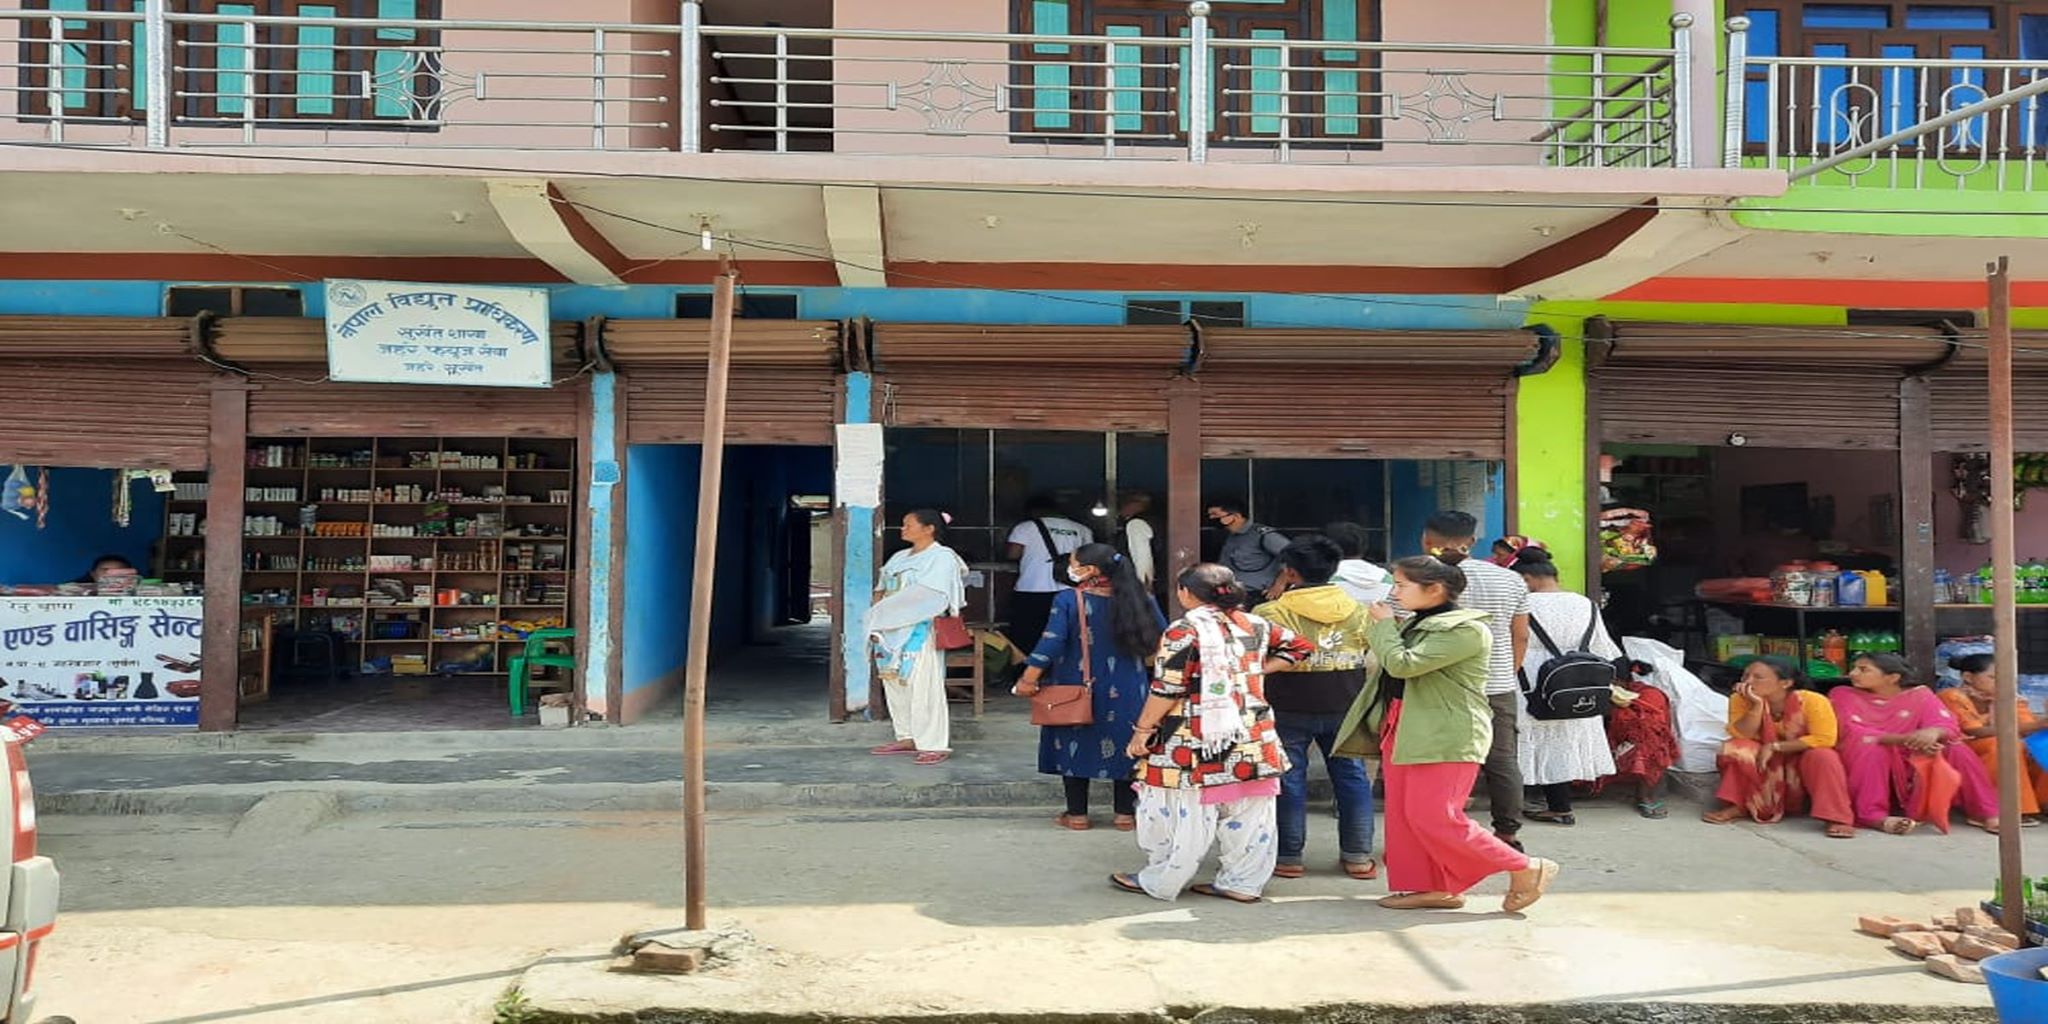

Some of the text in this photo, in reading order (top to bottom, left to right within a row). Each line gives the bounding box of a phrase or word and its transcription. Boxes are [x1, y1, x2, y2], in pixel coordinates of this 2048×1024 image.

[448, 327, 487, 339] शाखा
[463, 296, 540, 345] प्राधिकरण
[3, 624, 57, 651] एण्ड
